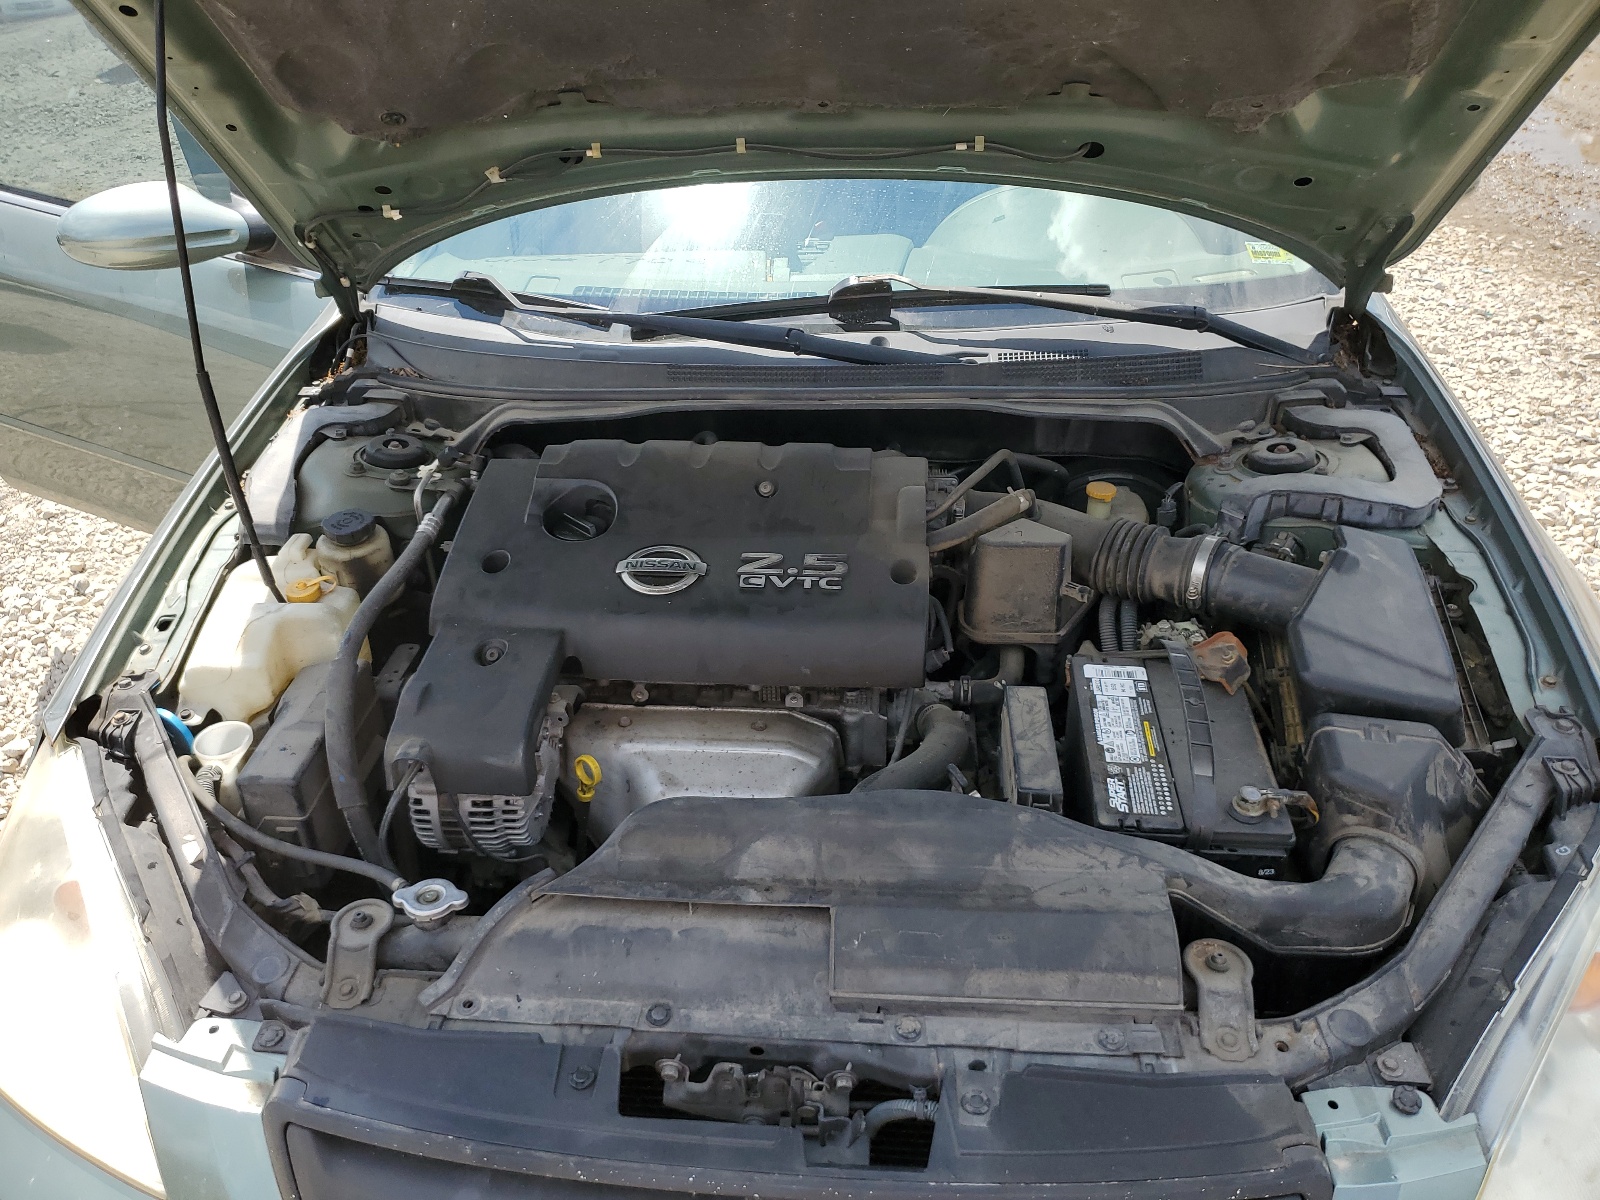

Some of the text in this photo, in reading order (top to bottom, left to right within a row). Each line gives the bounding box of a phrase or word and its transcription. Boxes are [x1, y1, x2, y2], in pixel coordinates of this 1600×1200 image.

[624, 558, 697, 571] NISSAN
[736, 551, 849, 575] 2.5
[1106, 777, 1117, 808] SUPER
[1115, 780, 1129, 814] START
